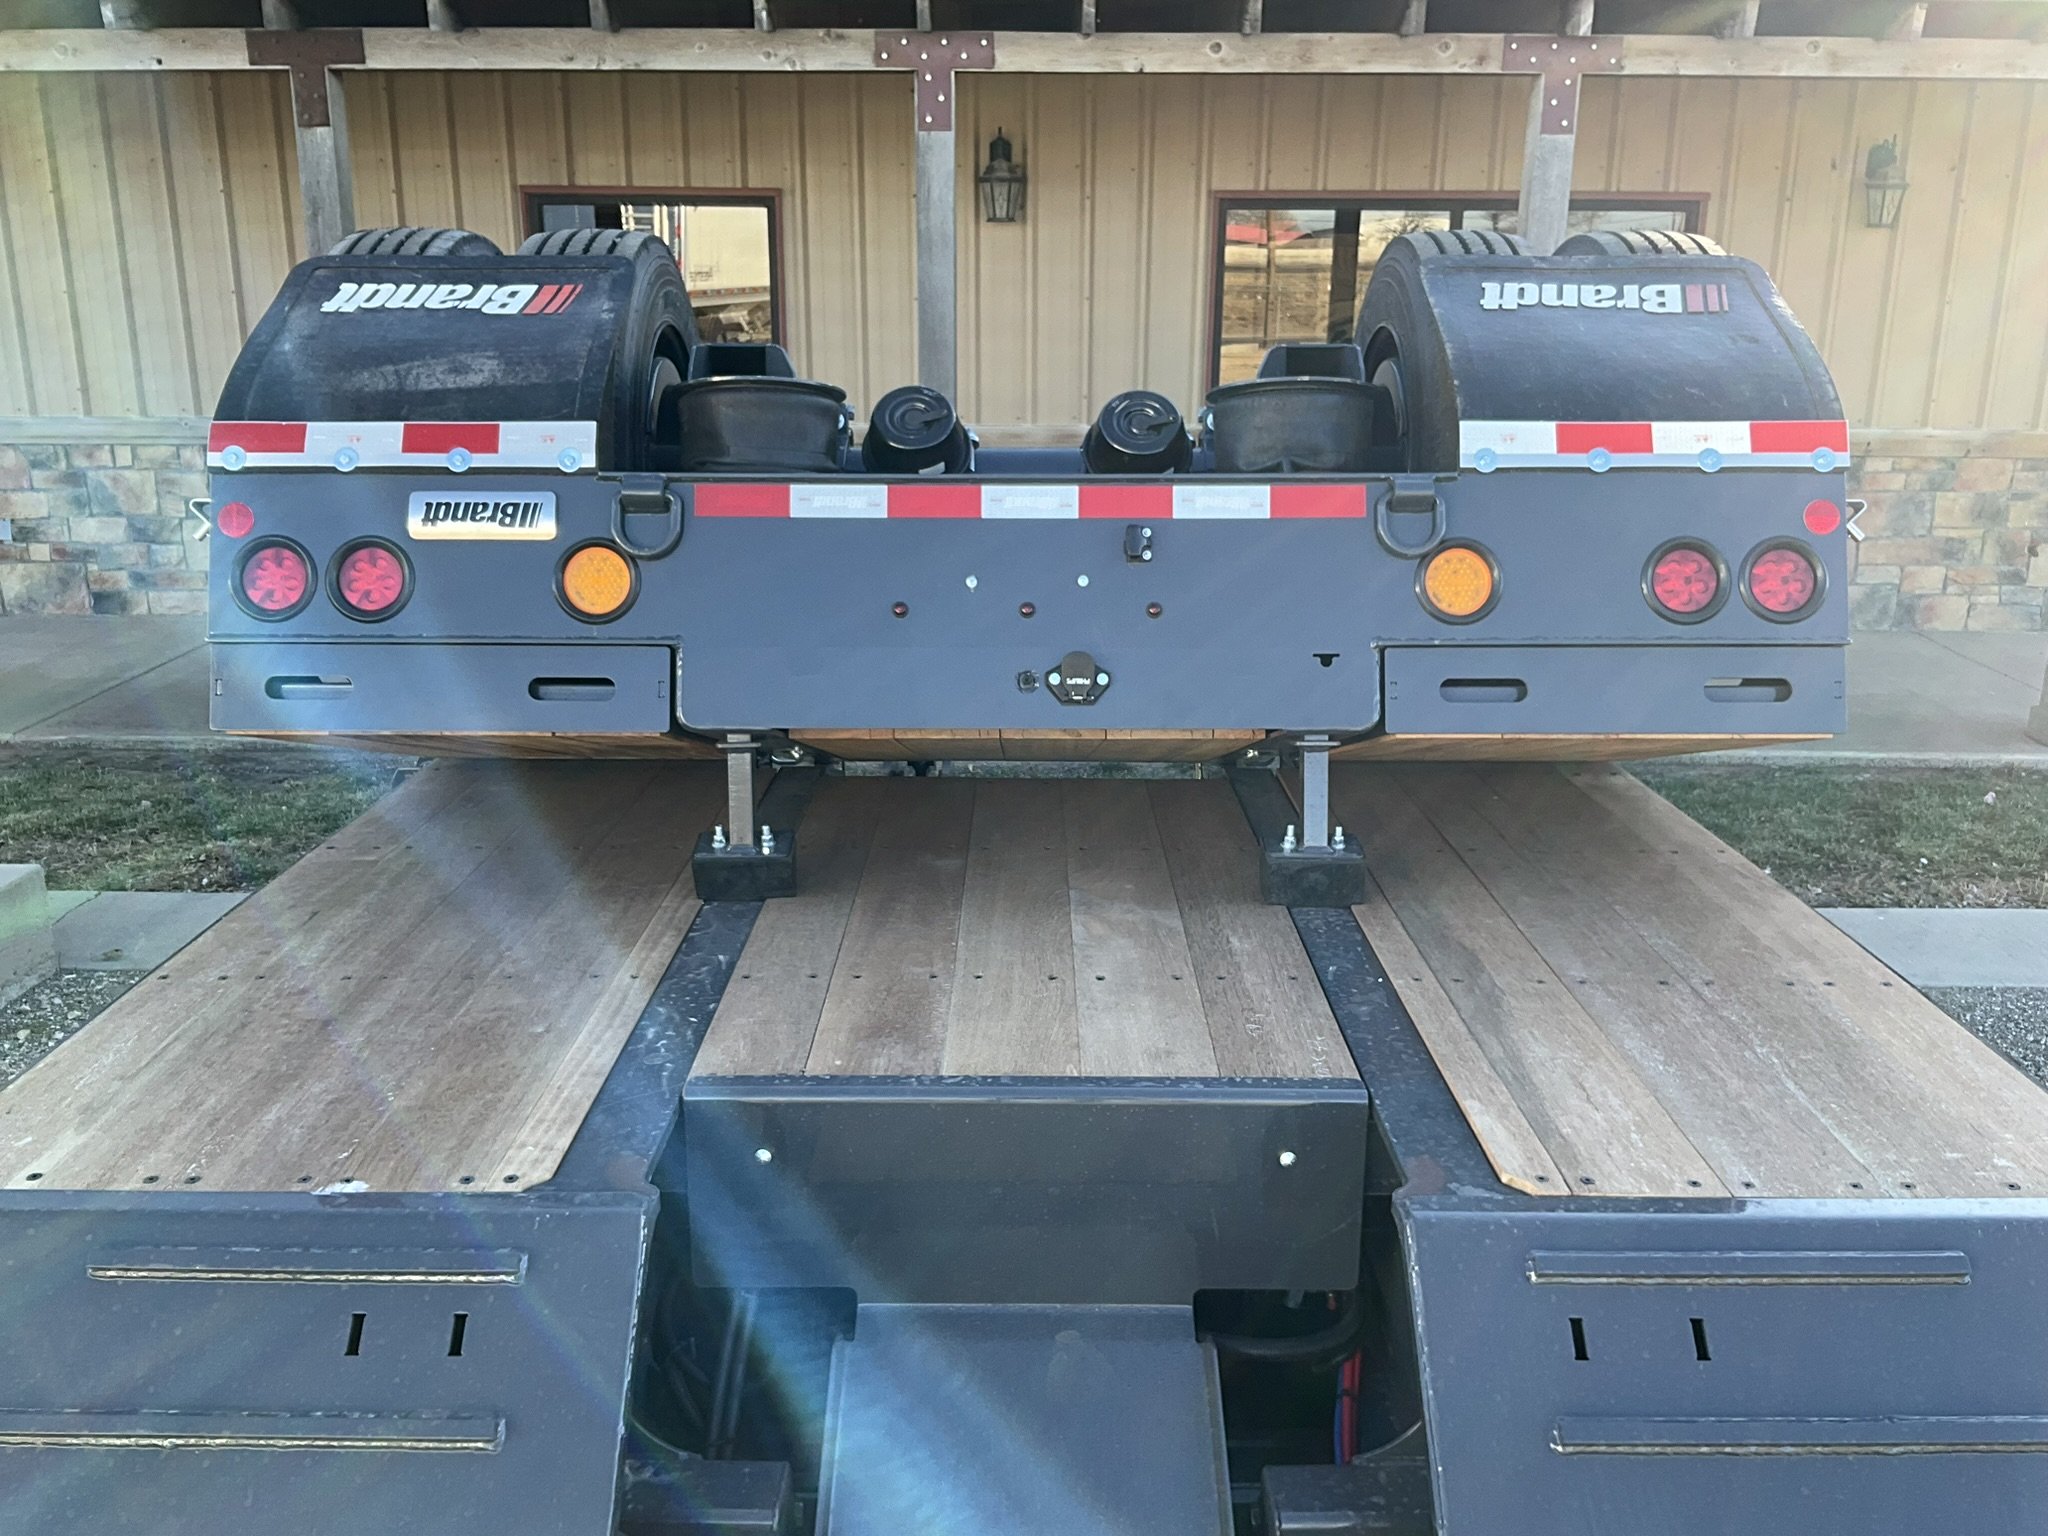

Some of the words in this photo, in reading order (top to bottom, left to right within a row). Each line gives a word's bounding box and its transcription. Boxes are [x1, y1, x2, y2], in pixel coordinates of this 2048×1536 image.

[320, 282, 538, 314] Brandt
[1480, 282, 1683, 313] Brandt
[421, 501, 520, 528] Brandt
